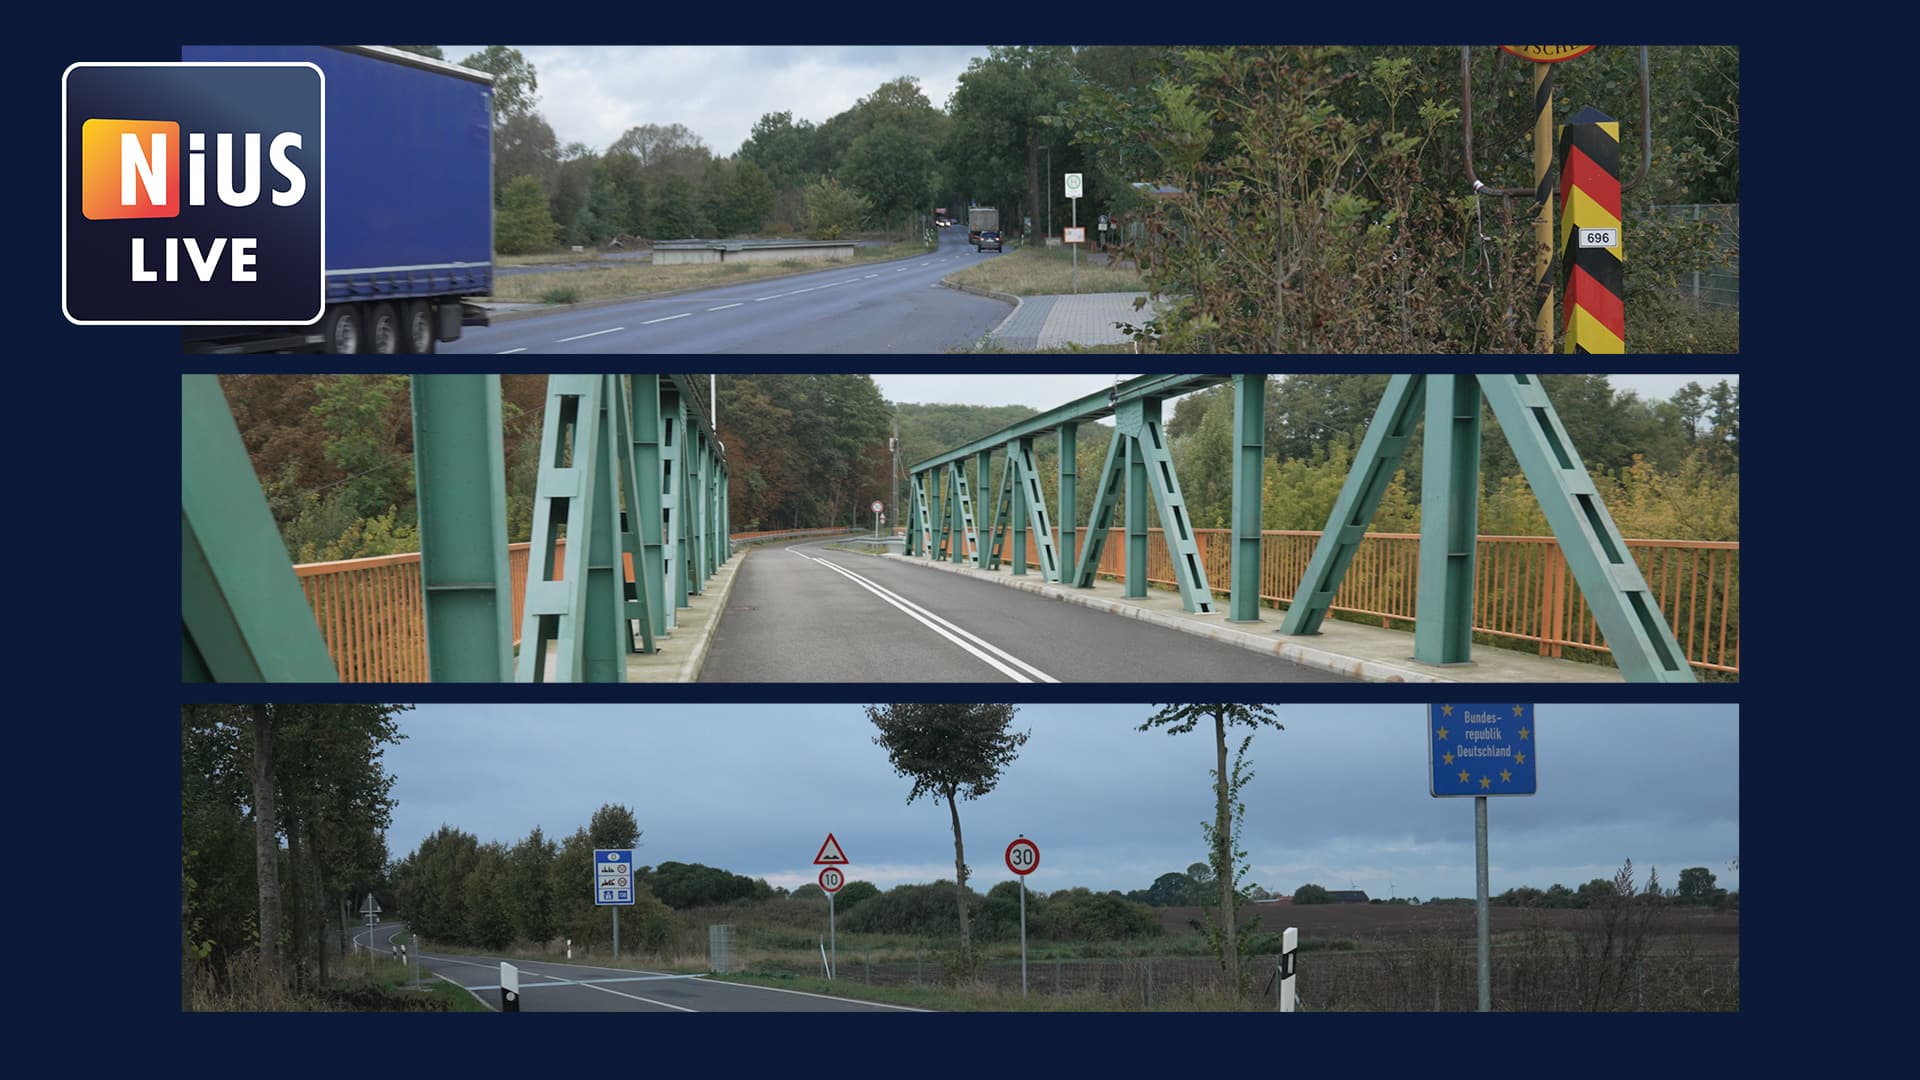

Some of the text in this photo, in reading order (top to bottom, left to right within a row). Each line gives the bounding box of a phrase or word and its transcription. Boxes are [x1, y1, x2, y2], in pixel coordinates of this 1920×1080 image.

[1587, 232, 1609, 243] 696
[1464, 711, 1502, 723] Bundes-
[1465, 728, 1502, 742] republik
[1457, 745, 1511, 757] Deutschland
[1012, 848, 1033, 865] 30
[825, 874, 838, 885] 10
